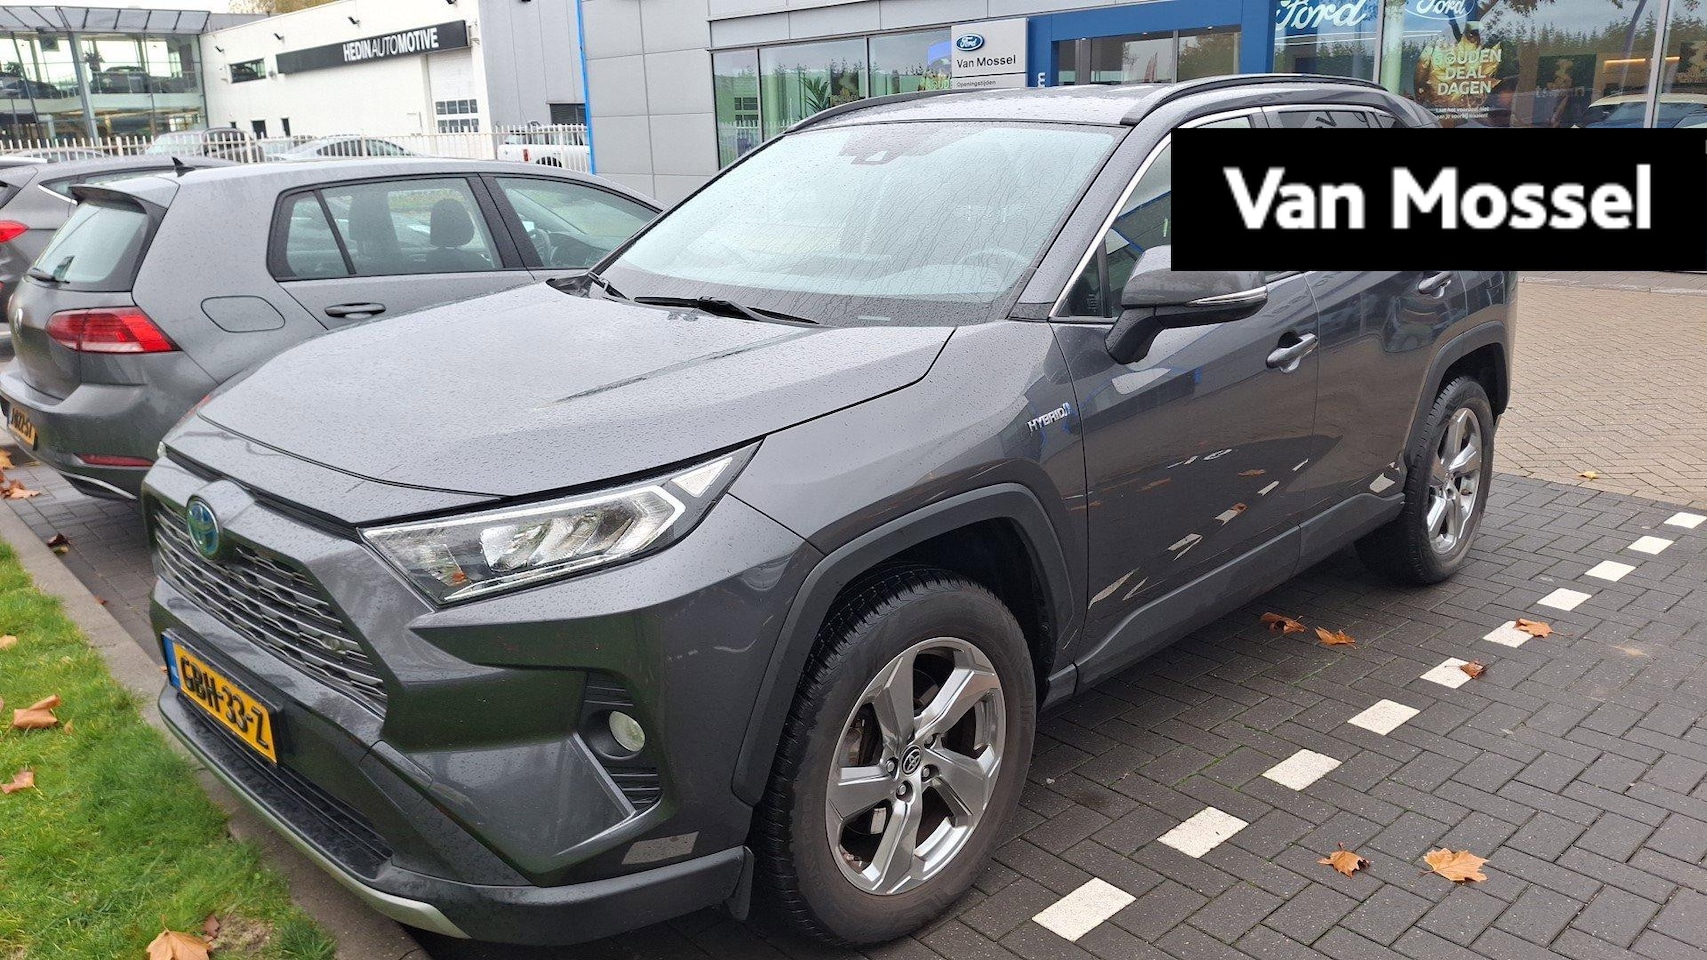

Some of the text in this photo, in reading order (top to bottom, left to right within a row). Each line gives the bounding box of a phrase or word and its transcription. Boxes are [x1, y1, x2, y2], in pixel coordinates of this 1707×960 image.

[956, 54, 1016, 68] Van Mossel
[1432, 48, 1502, 65] GOUDEN
[1445, 66, 1487, 80] DEAL
[956, 79, 997, 88] Openingstijden
[1437, 81, 1493, 95] DAGEN
[1027, 407, 1065, 432] HYBRID
[180, 656, 270, 750] GBH-33-Z
